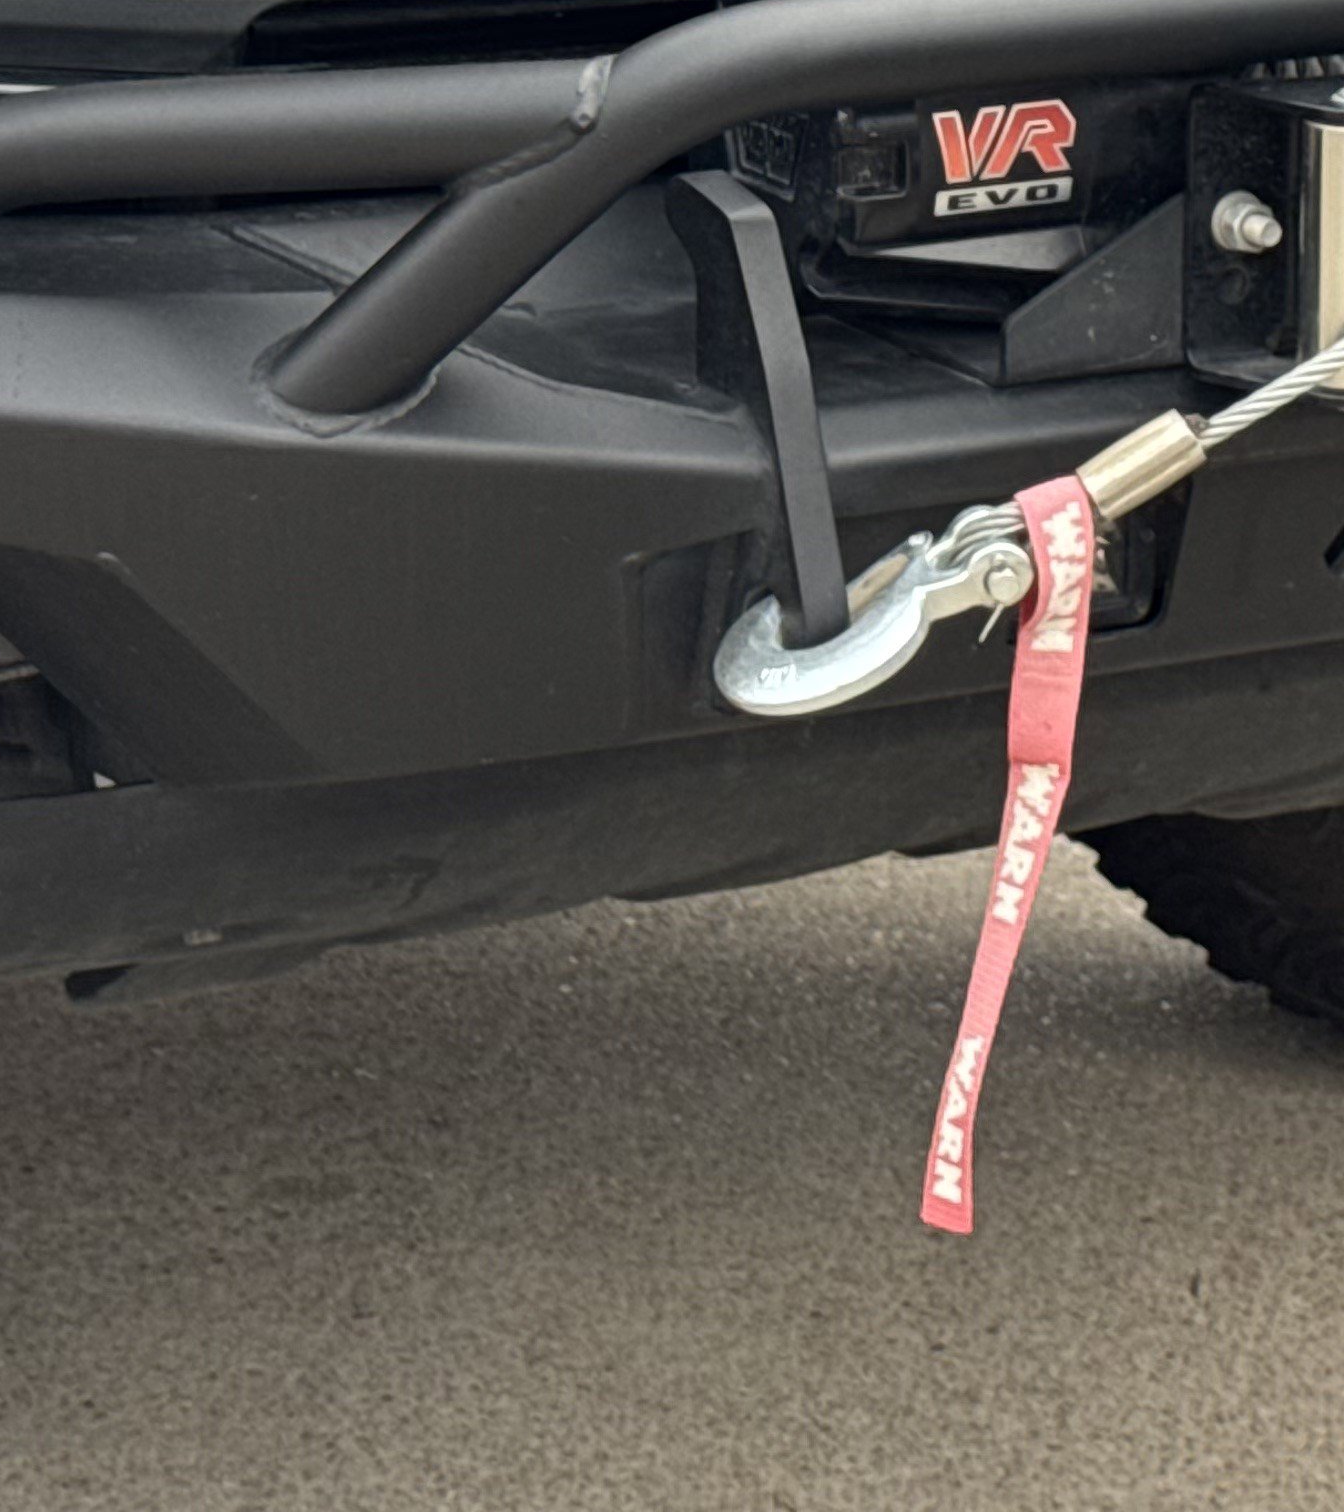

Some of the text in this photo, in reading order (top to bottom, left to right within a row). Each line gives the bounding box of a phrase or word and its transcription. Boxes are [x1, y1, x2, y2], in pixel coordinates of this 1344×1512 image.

[931, 99, 1077, 185] VR
[947, 184, 1059, 210] EVO
[1033, 500, 1088, 653] WARN
[992, 763, 1060, 925] WARN
[932, 1035, 985, 1204] WARN
